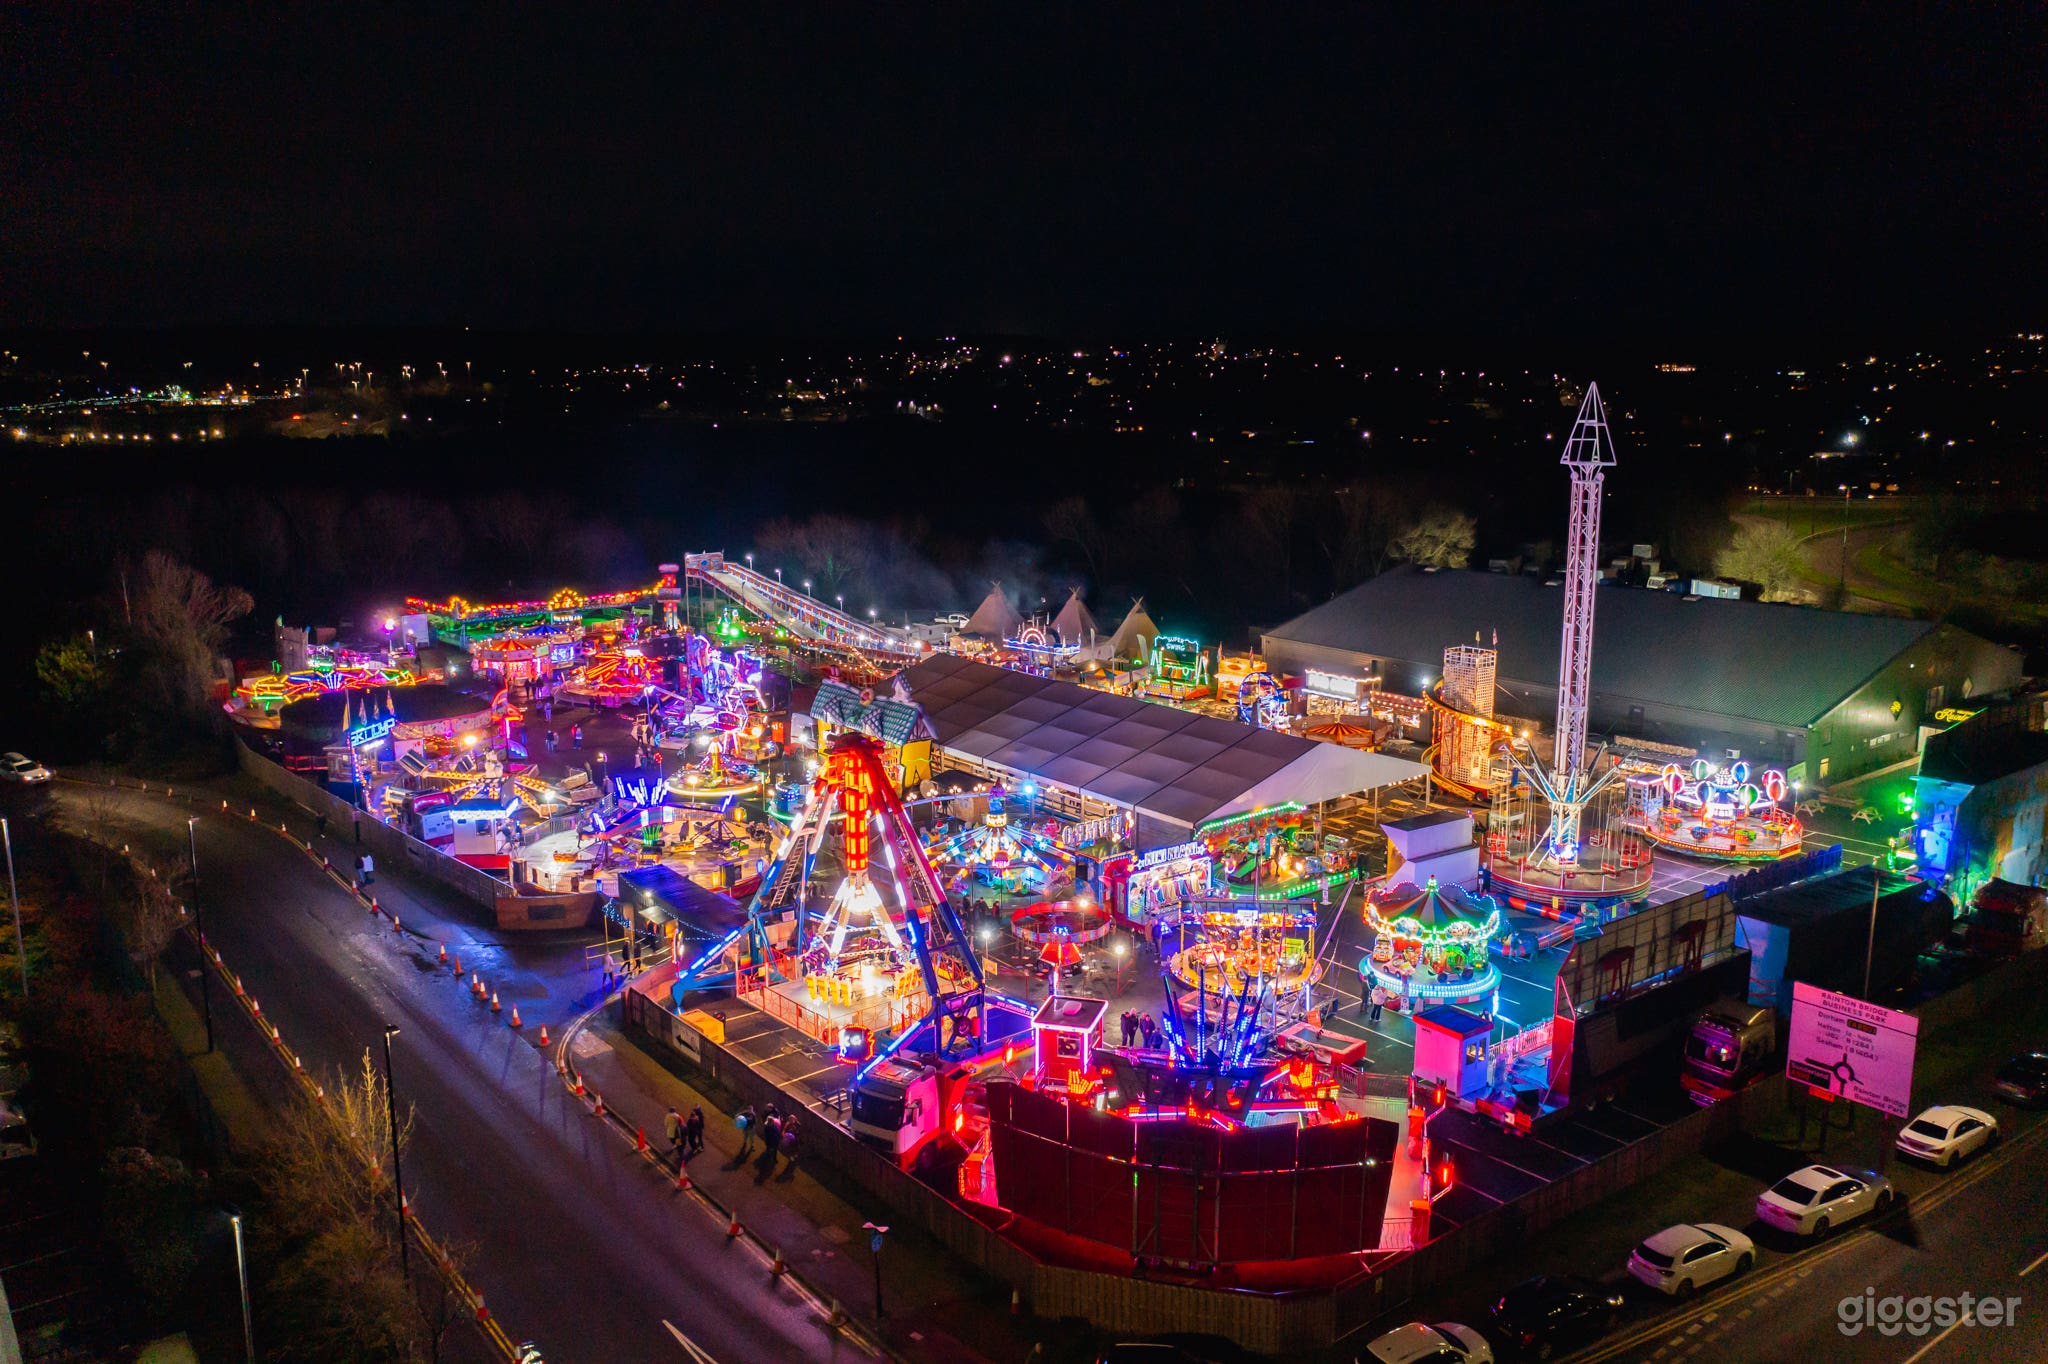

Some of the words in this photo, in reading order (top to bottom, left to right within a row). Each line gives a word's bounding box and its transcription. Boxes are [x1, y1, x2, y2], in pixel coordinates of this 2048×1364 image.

[1165, 643, 1186, 651] SWING
[1821, 992, 1856, 1007] RAINTON
[1859, 1004, 1888, 1017] BRIDGE
[1822, 999, 1862, 1017] BUSINESS
[1865, 1013, 1886, 1023] PARK
